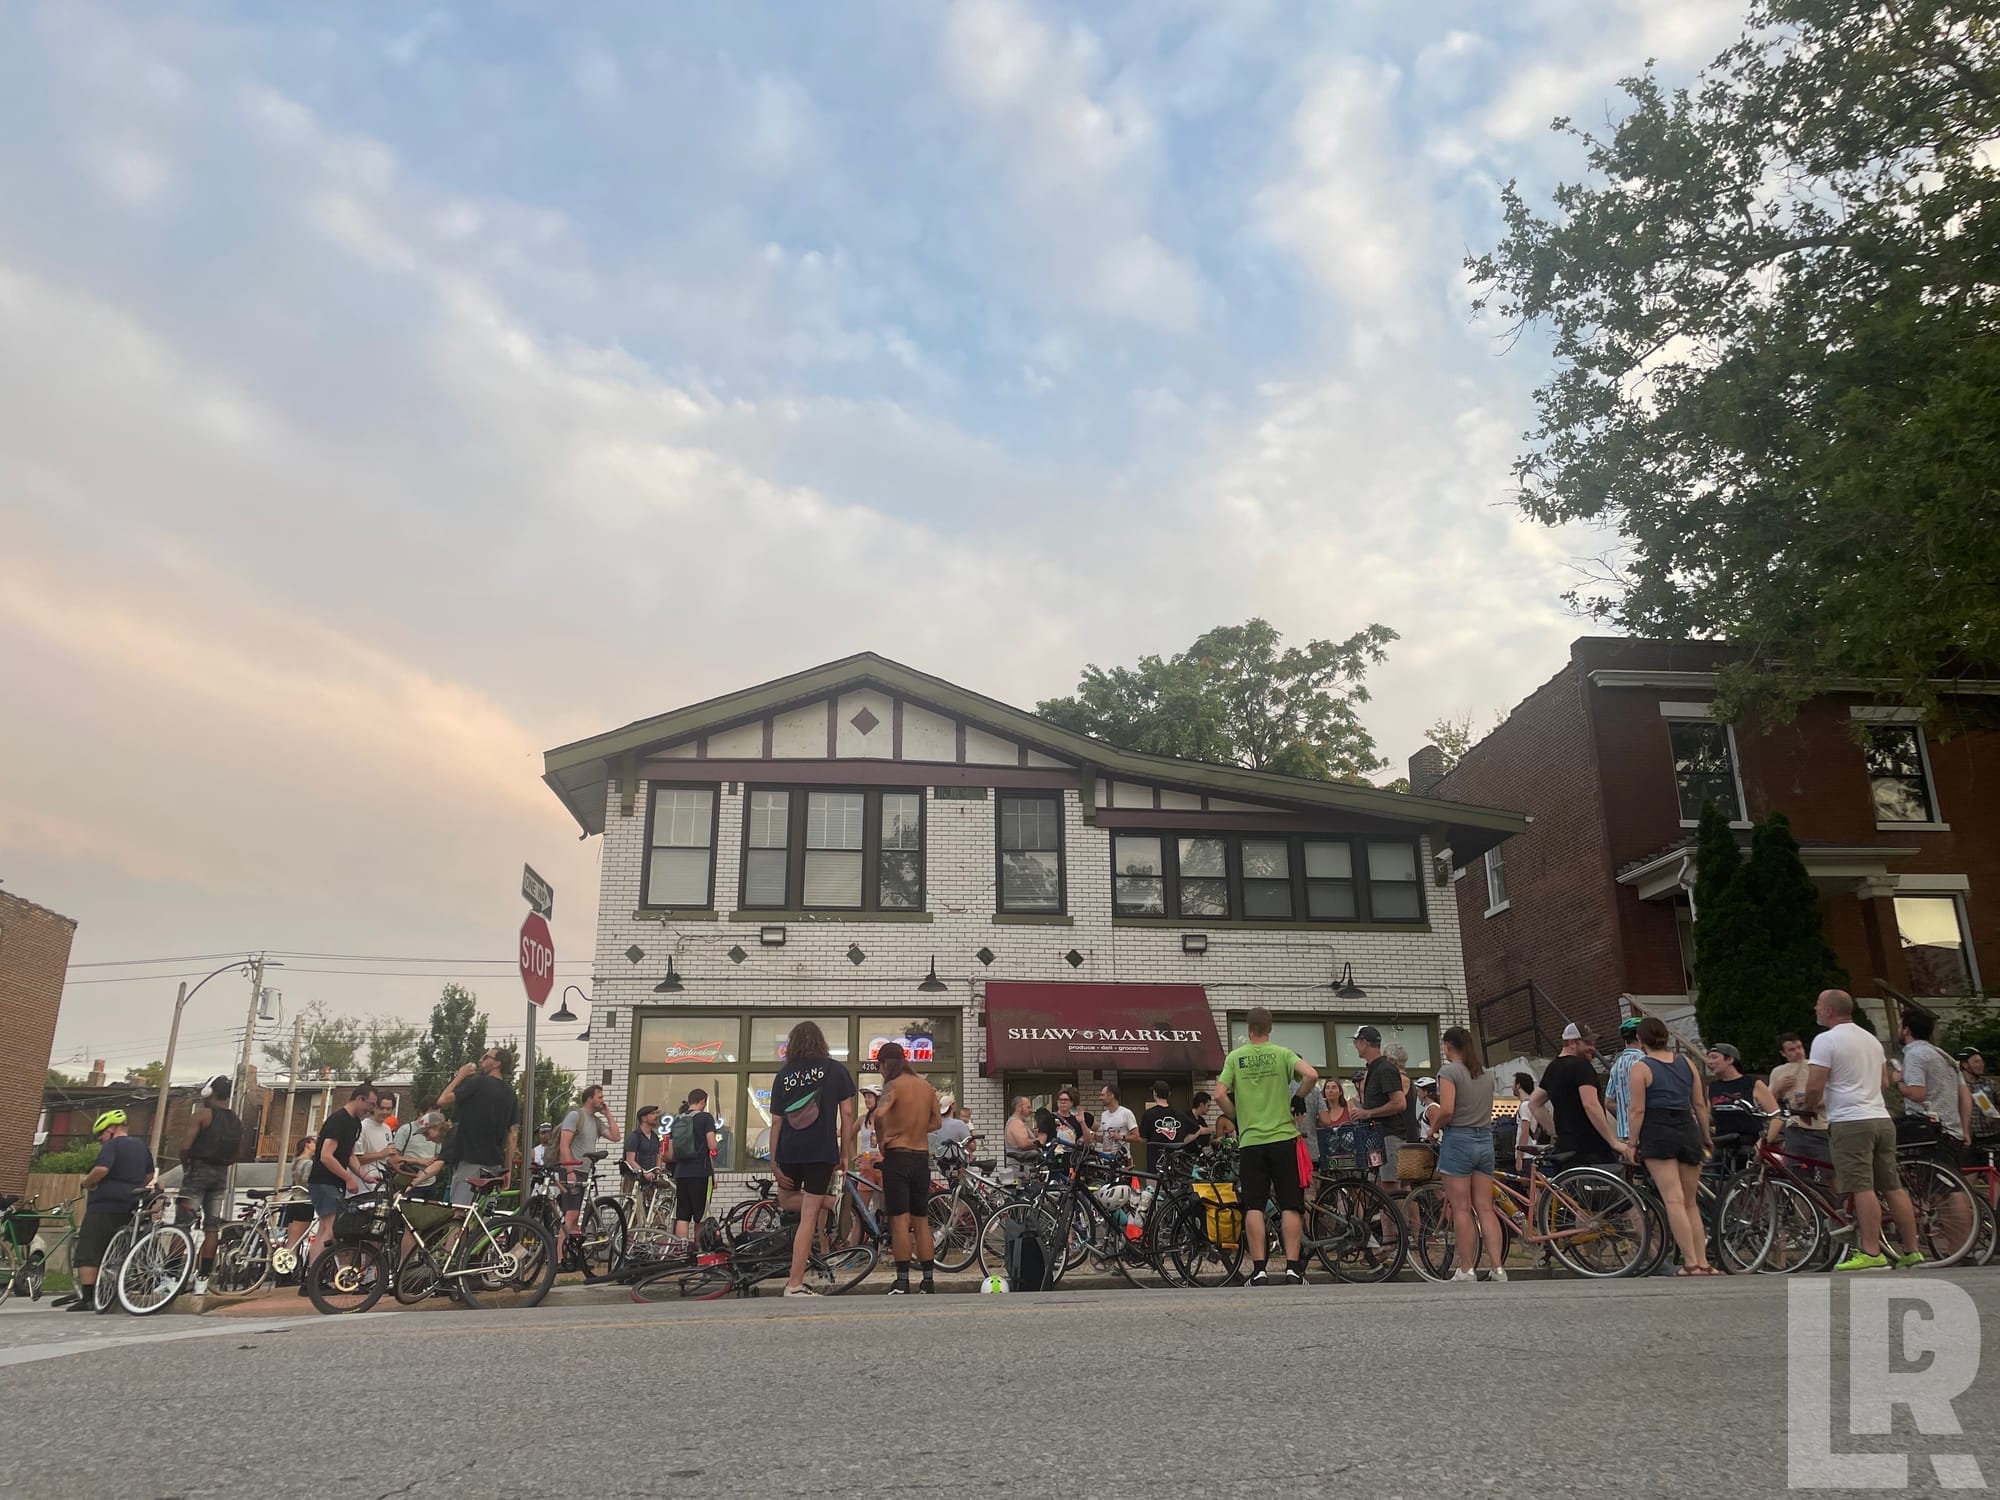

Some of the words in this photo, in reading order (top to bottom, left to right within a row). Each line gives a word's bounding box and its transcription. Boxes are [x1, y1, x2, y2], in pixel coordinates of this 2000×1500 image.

[525, 875, 536, 896] ONE
[522, 935, 552, 979] STOP
[1008, 1028, 1077, 1040] SHAW
[1099, 1028, 1202, 1042] MARKET
[665, 1047, 719, 1058] Budweiser
